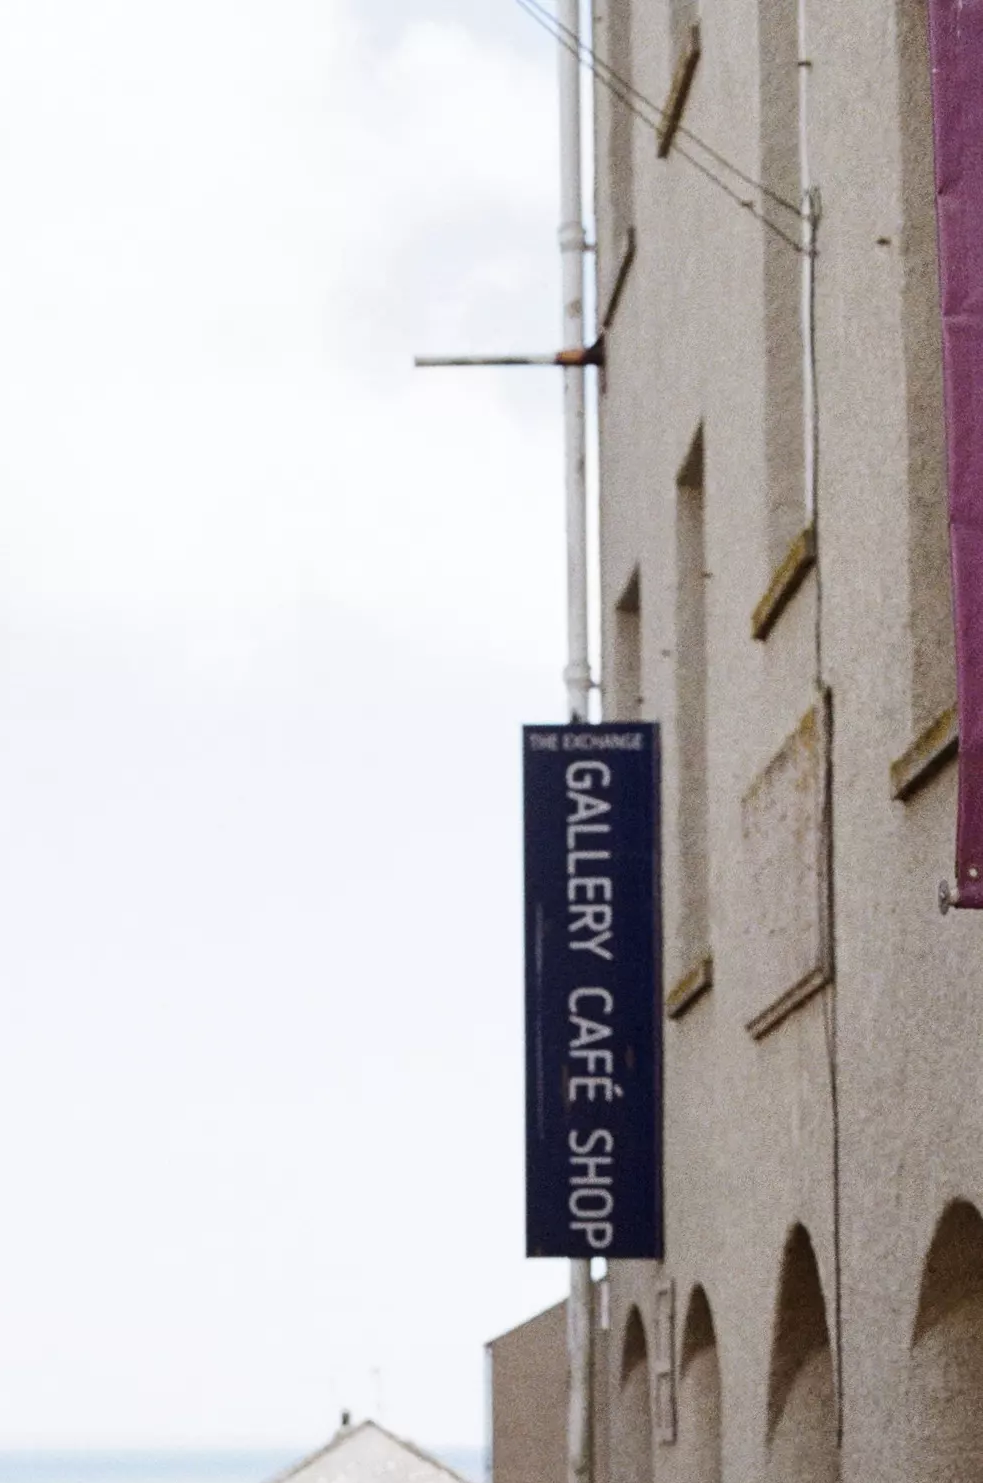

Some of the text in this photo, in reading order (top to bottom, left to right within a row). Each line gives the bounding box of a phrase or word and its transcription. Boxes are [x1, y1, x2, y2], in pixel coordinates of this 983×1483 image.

[528, 732, 643, 752] THE EXCHANGE
[565, 760, 624, 1249] GALLERY CAFÉ SHOP
